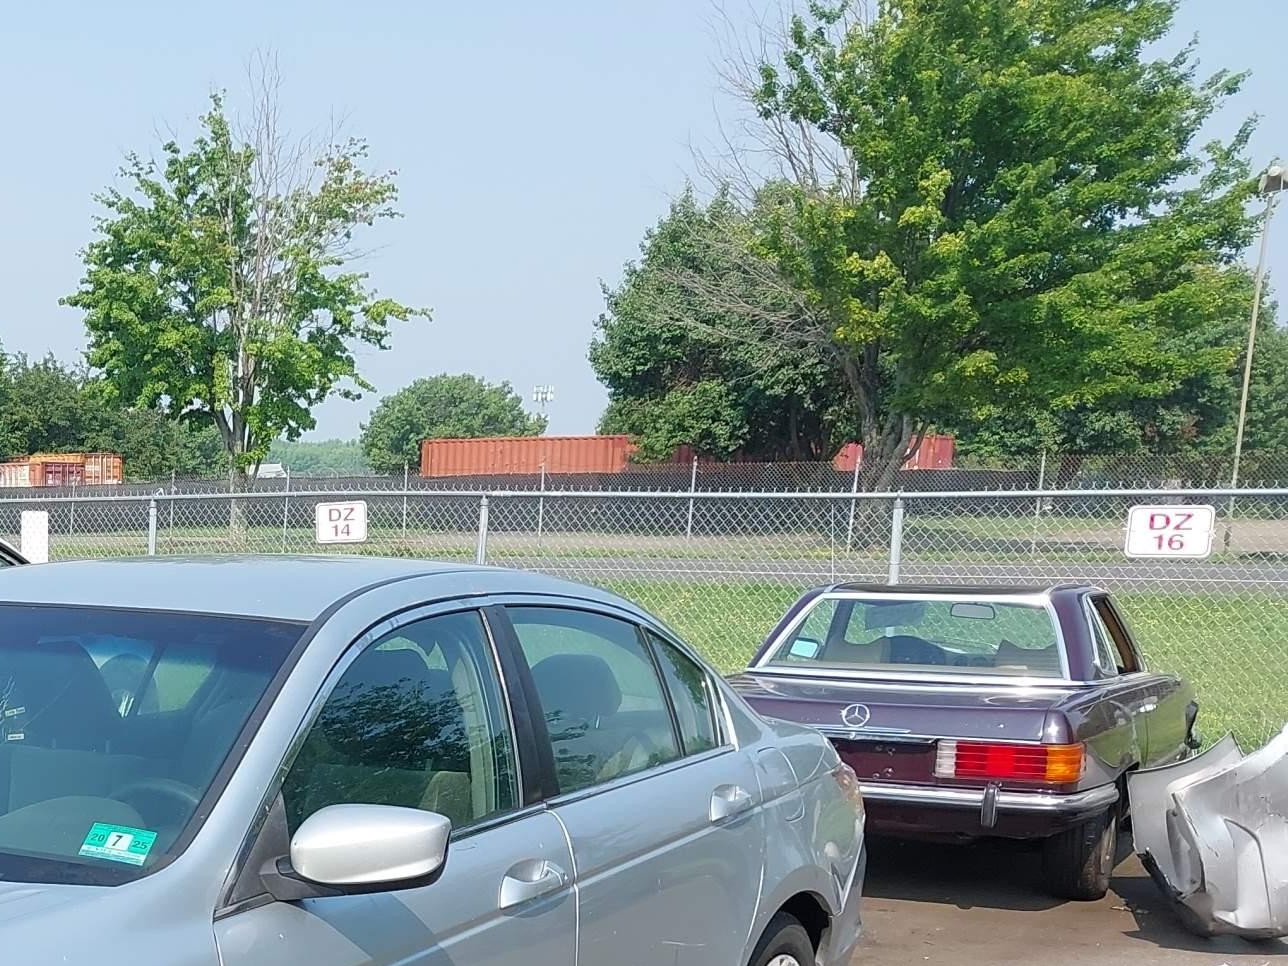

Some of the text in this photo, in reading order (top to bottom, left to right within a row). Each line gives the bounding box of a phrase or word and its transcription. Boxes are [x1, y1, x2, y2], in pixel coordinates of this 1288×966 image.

[329, 507, 355, 522] DZ
[1149, 513, 1193, 530] DZ
[331, 524, 352, 537] 14
[1153, 534, 1184, 550] 16
[91, 833, 149, 850] 20 7 25
